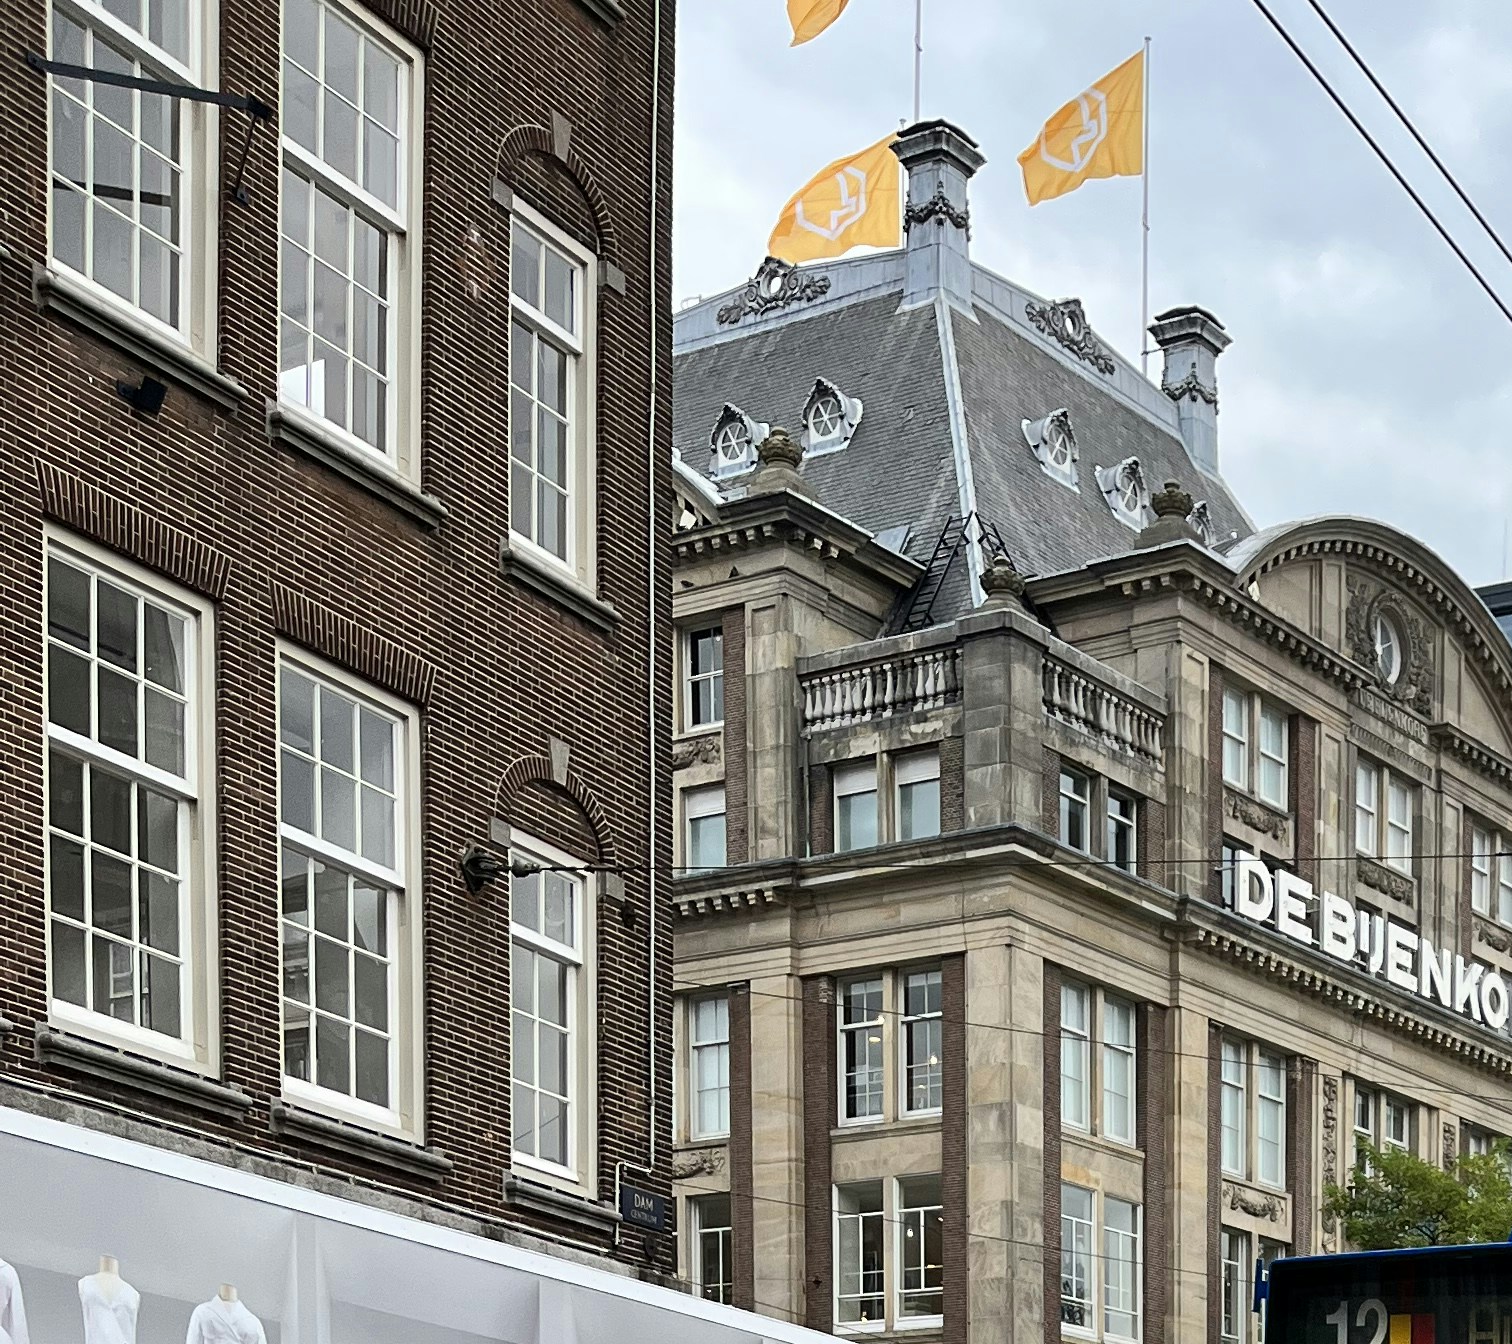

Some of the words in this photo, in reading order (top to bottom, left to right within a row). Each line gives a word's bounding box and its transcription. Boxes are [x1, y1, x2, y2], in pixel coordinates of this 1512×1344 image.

[1235, 850, 1313, 945] DE
[634, 1193, 654, 1212] DAM
[630, 1209, 657, 1225] CENTRUM
